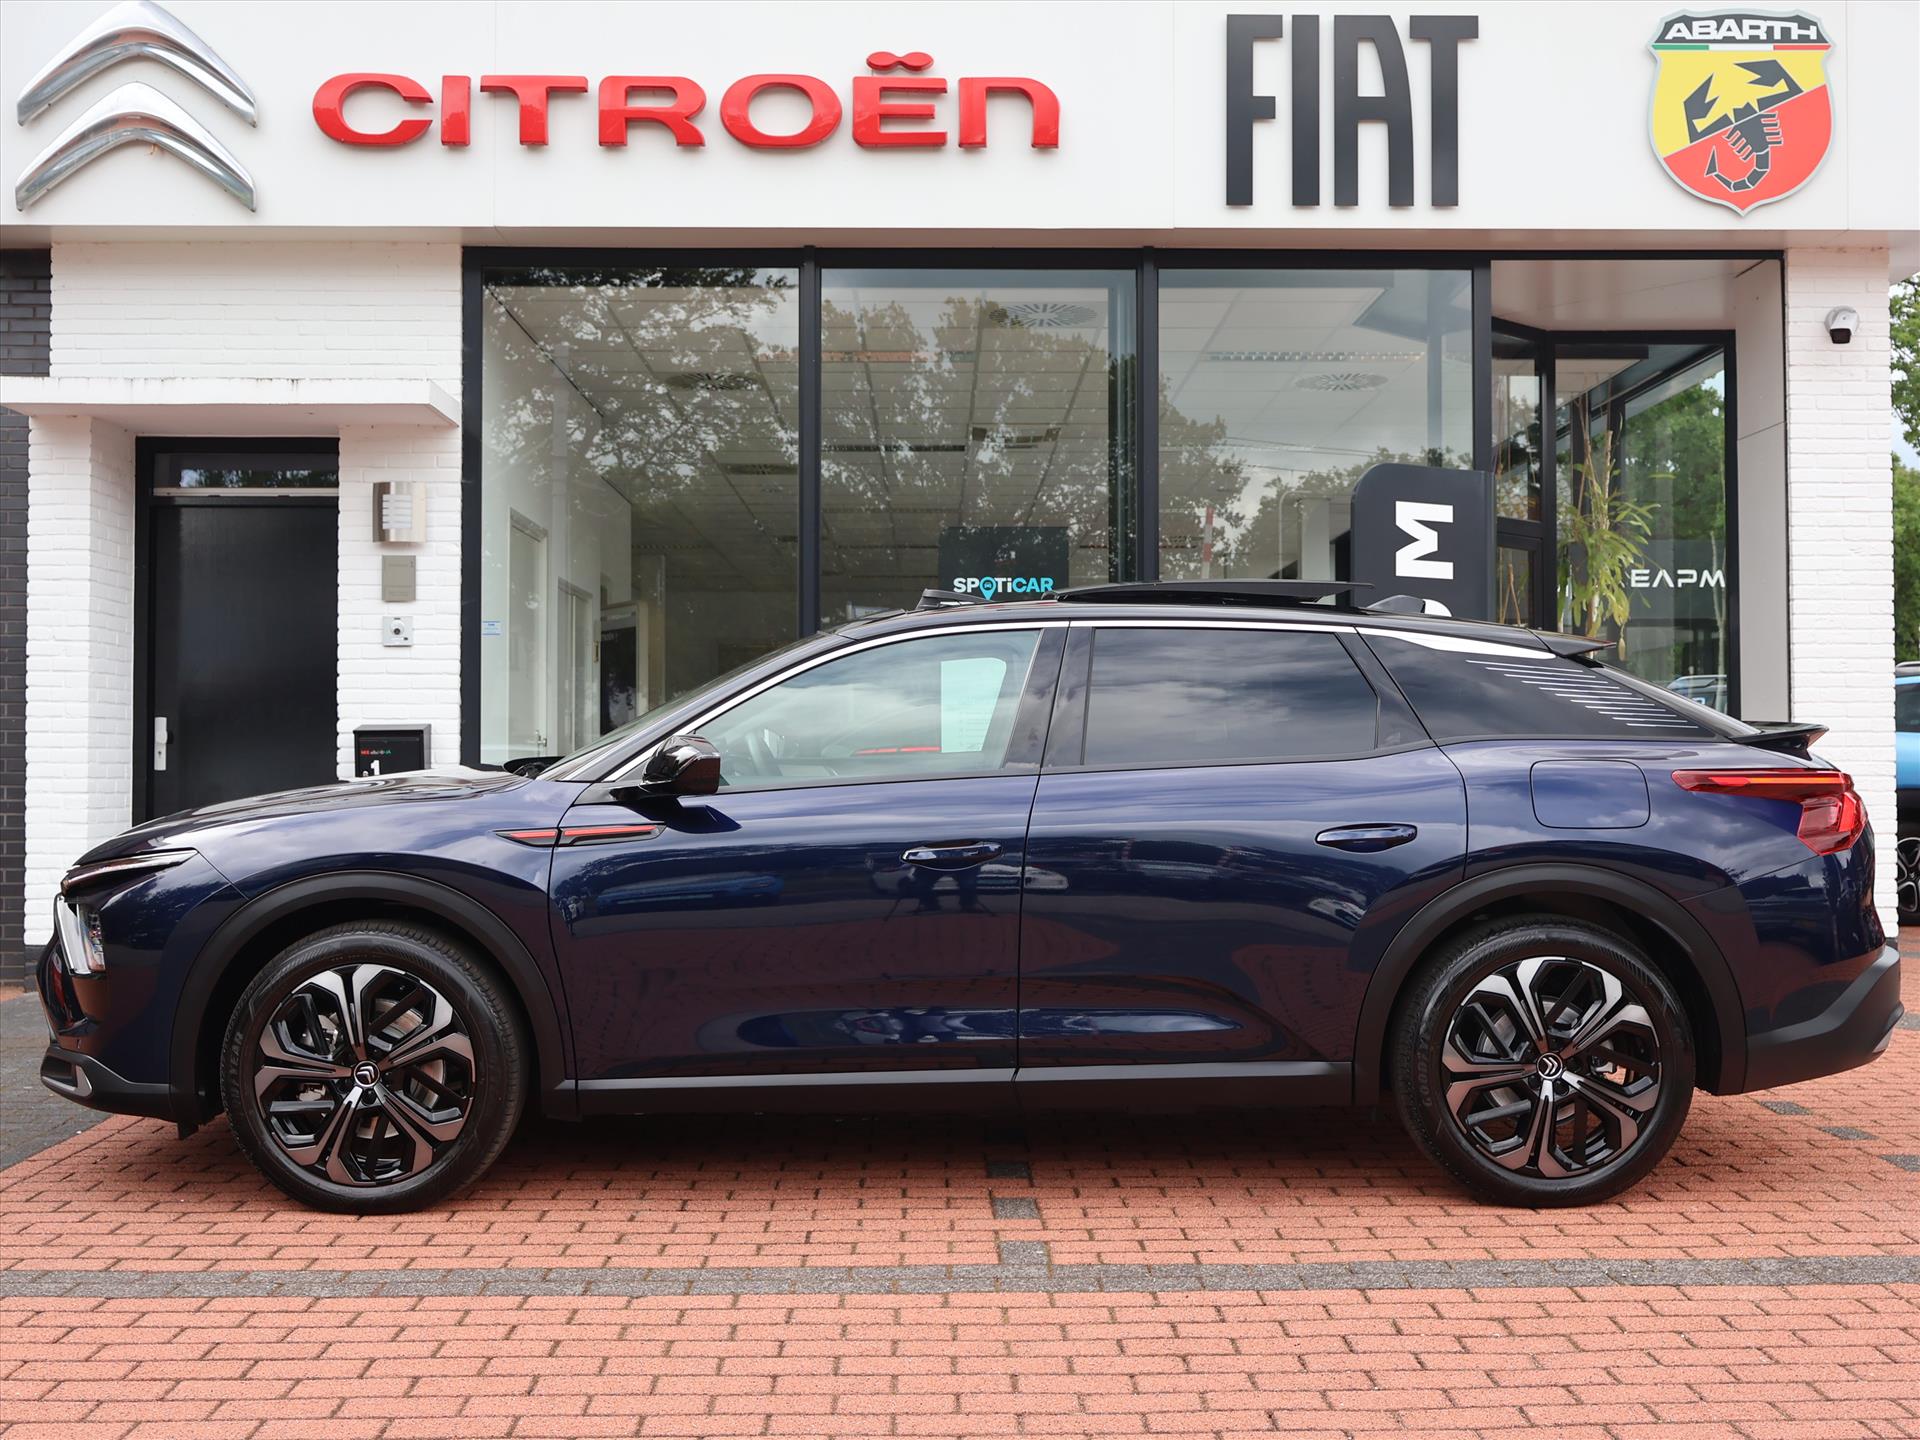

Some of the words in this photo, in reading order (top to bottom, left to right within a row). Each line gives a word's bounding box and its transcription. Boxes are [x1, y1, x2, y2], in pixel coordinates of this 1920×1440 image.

[1664, 18, 1818, 41] ABARTH
[1227, 15, 1478, 207] FIAT
[370, 759, 380, 776] 1
